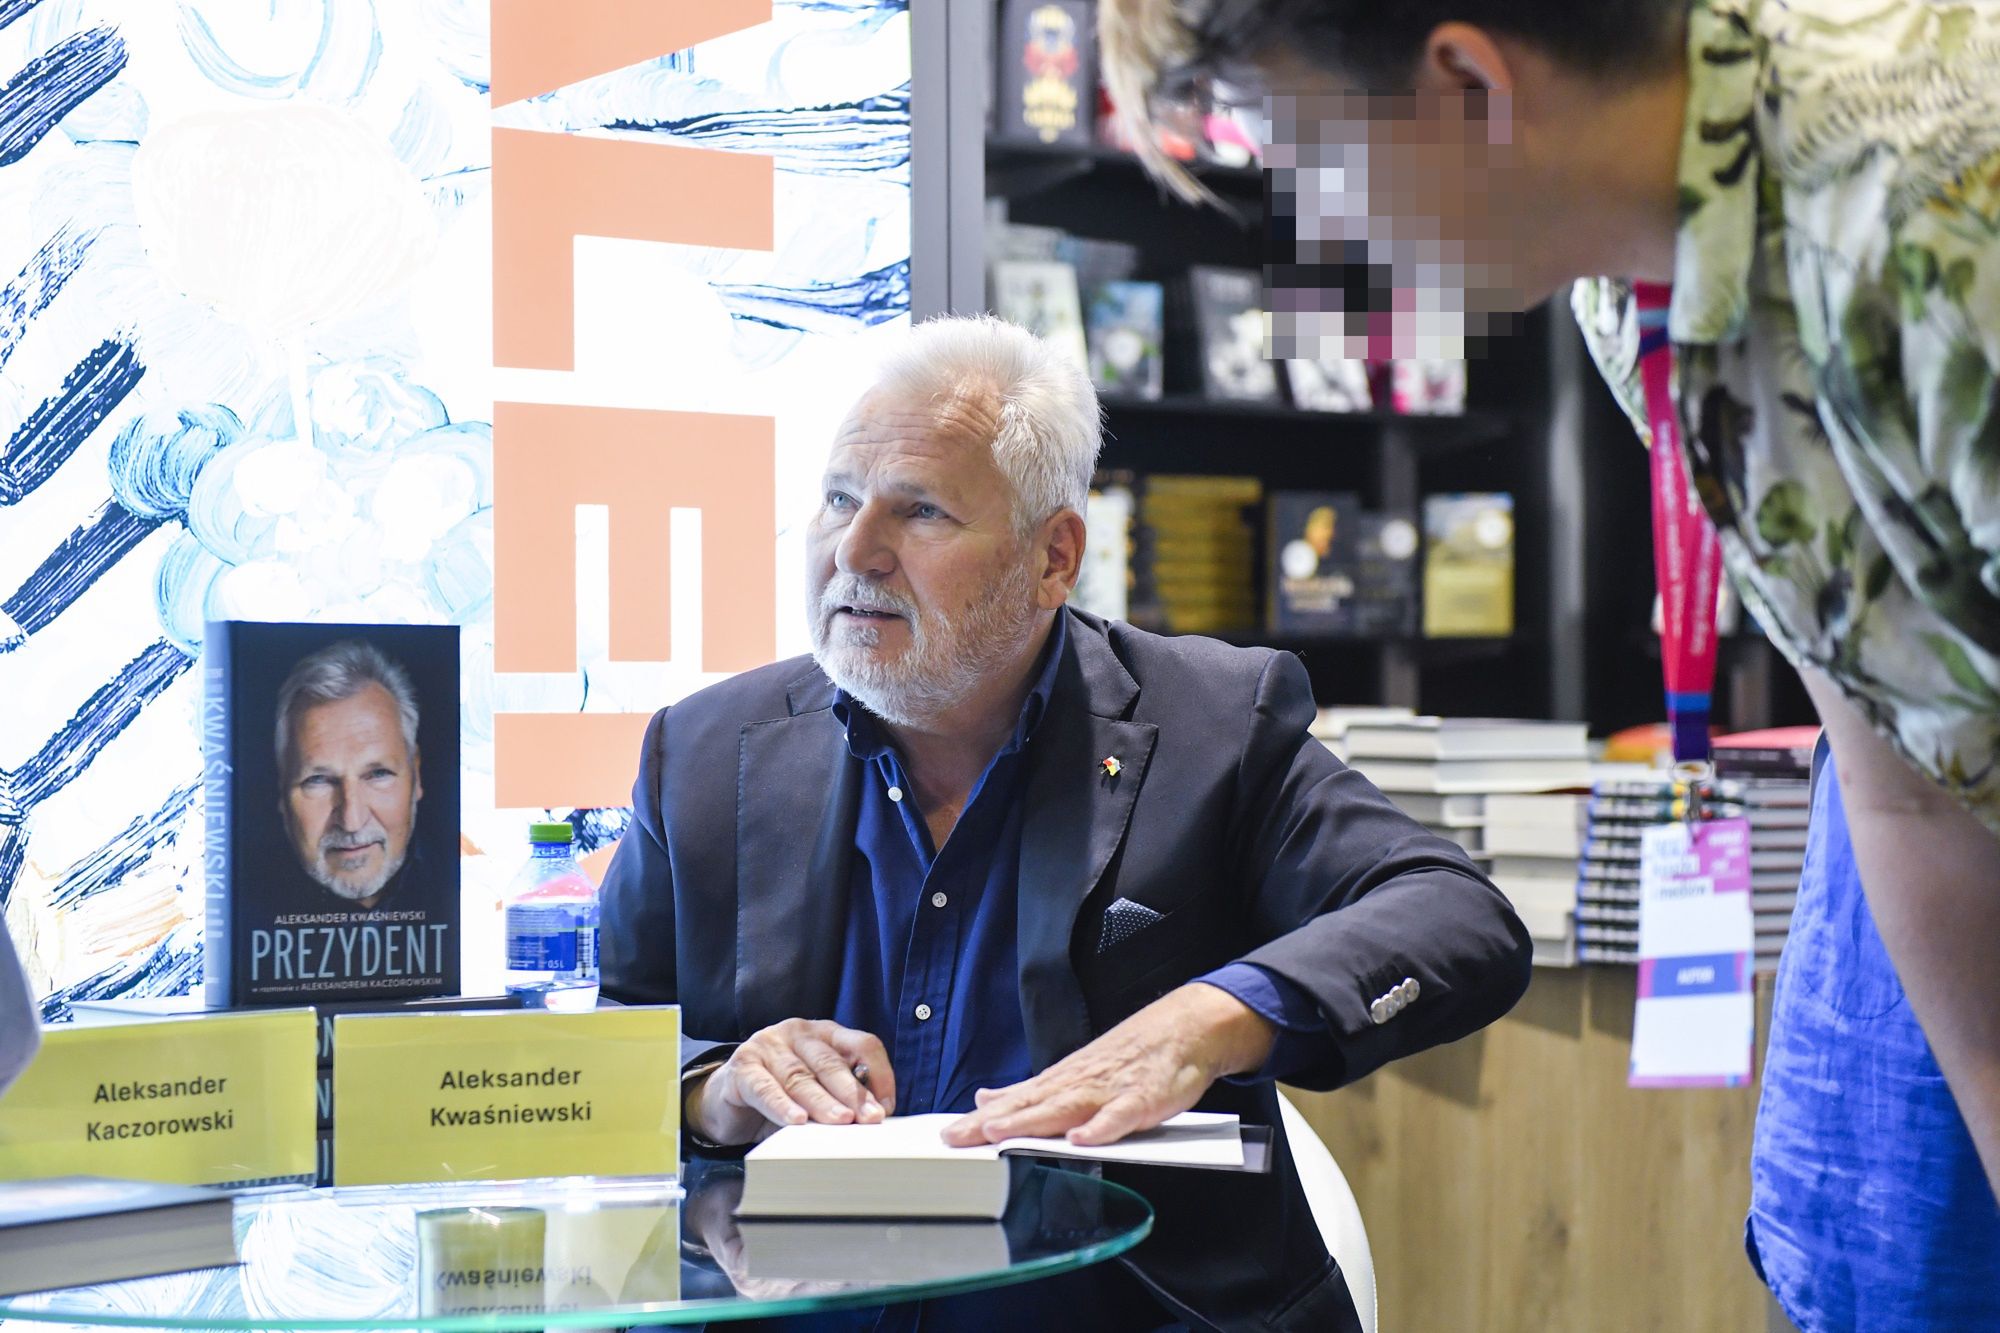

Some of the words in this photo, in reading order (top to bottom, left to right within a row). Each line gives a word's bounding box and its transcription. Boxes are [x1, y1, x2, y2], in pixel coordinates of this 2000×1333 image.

[204, 700, 233, 899] KWAŚNIEWSKI
[274, 913, 348, 925] ALEKSANDER
[350, 911, 426, 922] KWAŚNIEWSKI
[252, 924, 448, 980] PREZYDENT
[300, 981, 368, 991] ALEKSANDREM
[94, 1076, 227, 1104] Aleksander
[440, 1067, 582, 1090] Aleksander
[87, 1110, 233, 1141] Kaczorowski
[431, 1101, 591, 1127] Kwaśniewski
